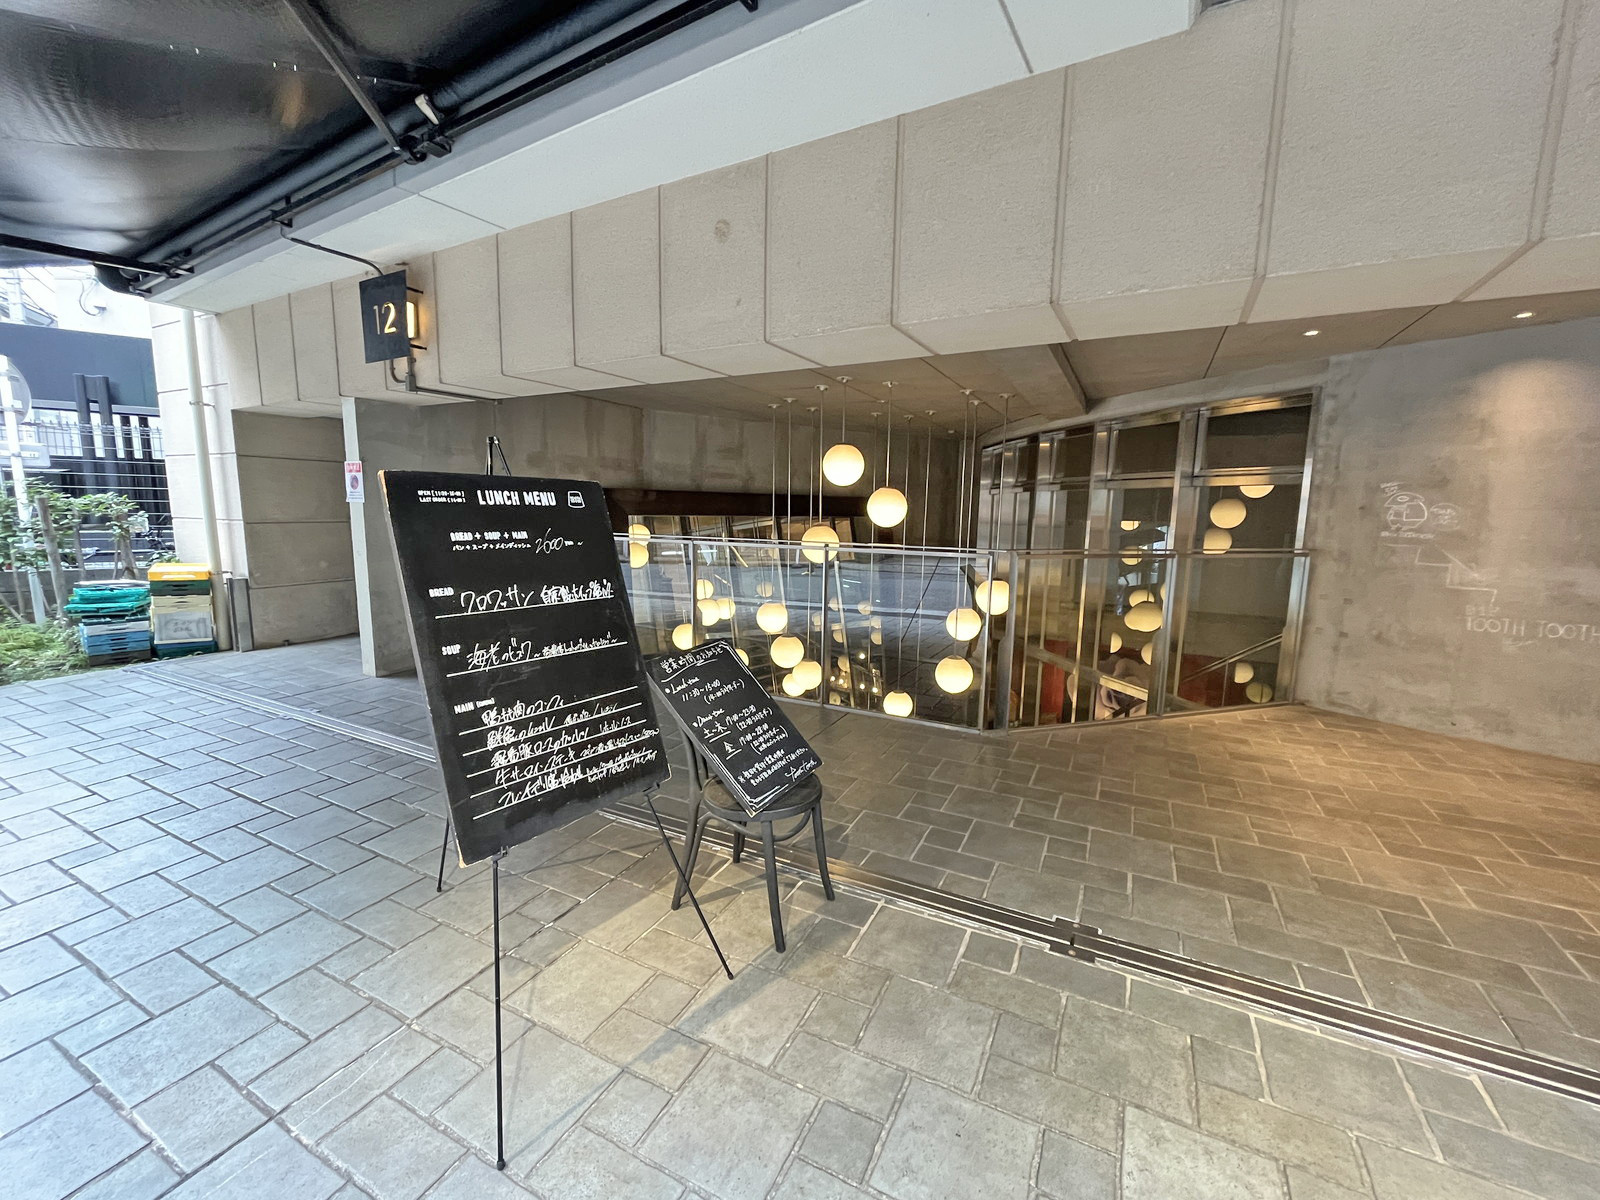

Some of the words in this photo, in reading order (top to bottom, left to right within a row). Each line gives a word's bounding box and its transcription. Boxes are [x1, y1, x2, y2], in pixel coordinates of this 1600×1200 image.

[373, 301, 397, 335] 12
[476, 489, 521, 506] LUNCH
[523, 491, 557, 507] MENU
[449, 531, 474, 541] BREAD
[483, 531, 501, 540] SOUP
[511, 530, 529, 540] MAIN
[535, 527, 564, 554] 2600
[472, 542, 489, 550] スープ
[428, 587, 455, 598] BREAD
[1464, 616, 1526, 637] TOOTH
[1537, 619, 1600, 643] TOOTH
[441, 644, 461, 656] SOUP
[660, 647, 724, 674] 営業時間のお知らせ
[453, 701, 475, 715] MAIN
[723, 741, 736, 754] 金
